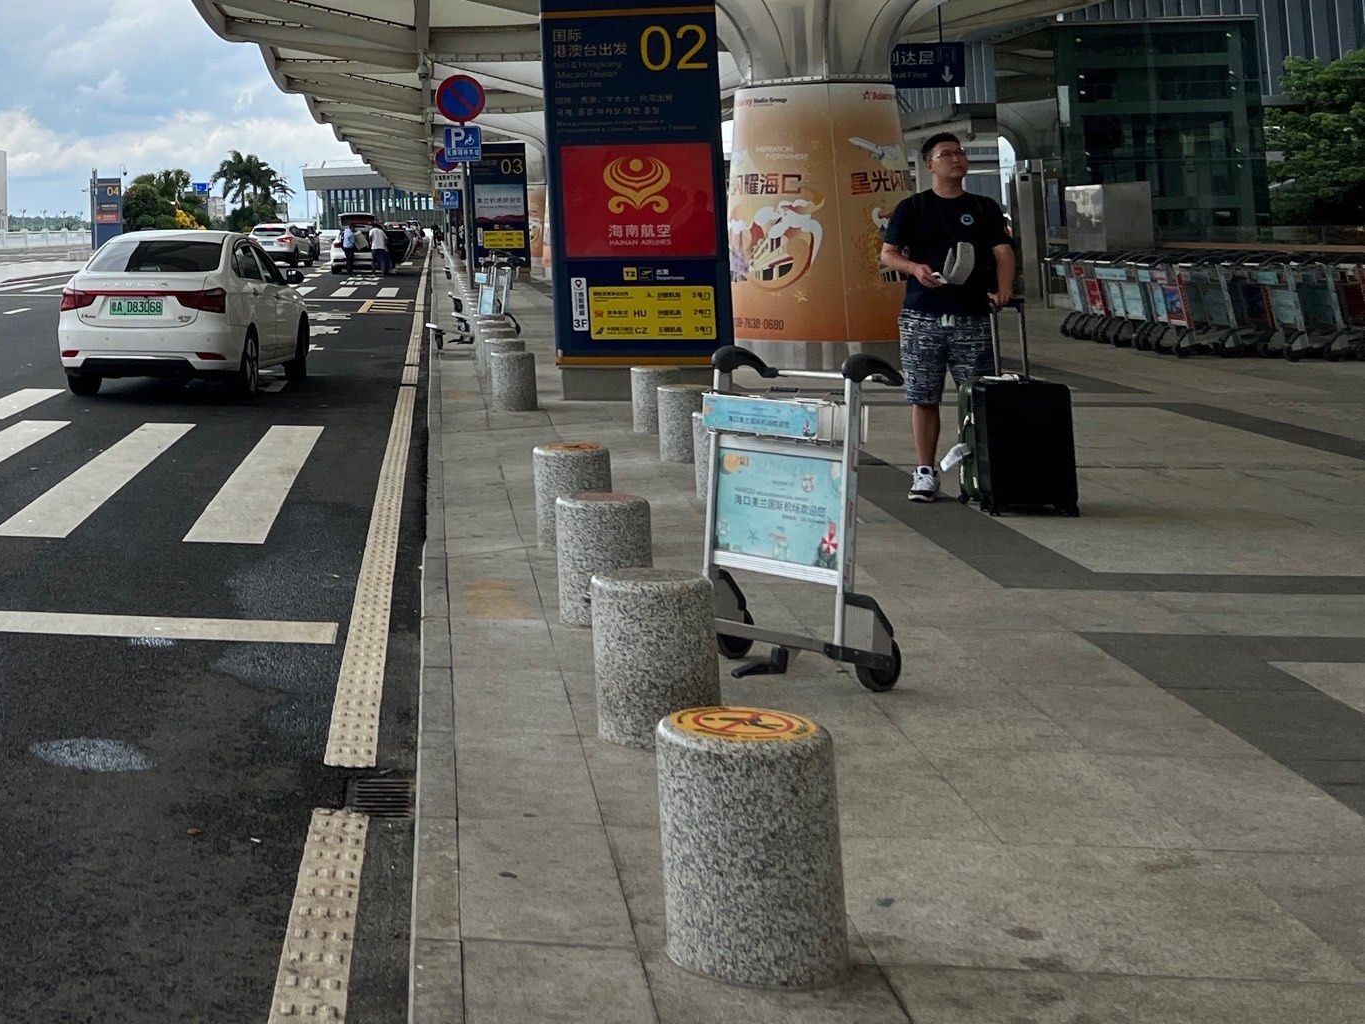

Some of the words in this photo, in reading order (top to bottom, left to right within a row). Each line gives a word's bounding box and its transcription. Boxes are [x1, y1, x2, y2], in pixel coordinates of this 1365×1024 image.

[552, 28, 582, 42] 国际
[553, 42, 628, 58] 港澳台出发
[640, 25, 709, 72] 02
[451, 128, 465, 149] P
[500, 159, 524, 175] 03
[107, 186, 119, 196] 04
[608, 224, 672, 238] 海南航空
[641, 238, 672, 246] AIRLINES
[633, 309, 647, 317] HU
[574, 319, 587, 328] 3F
